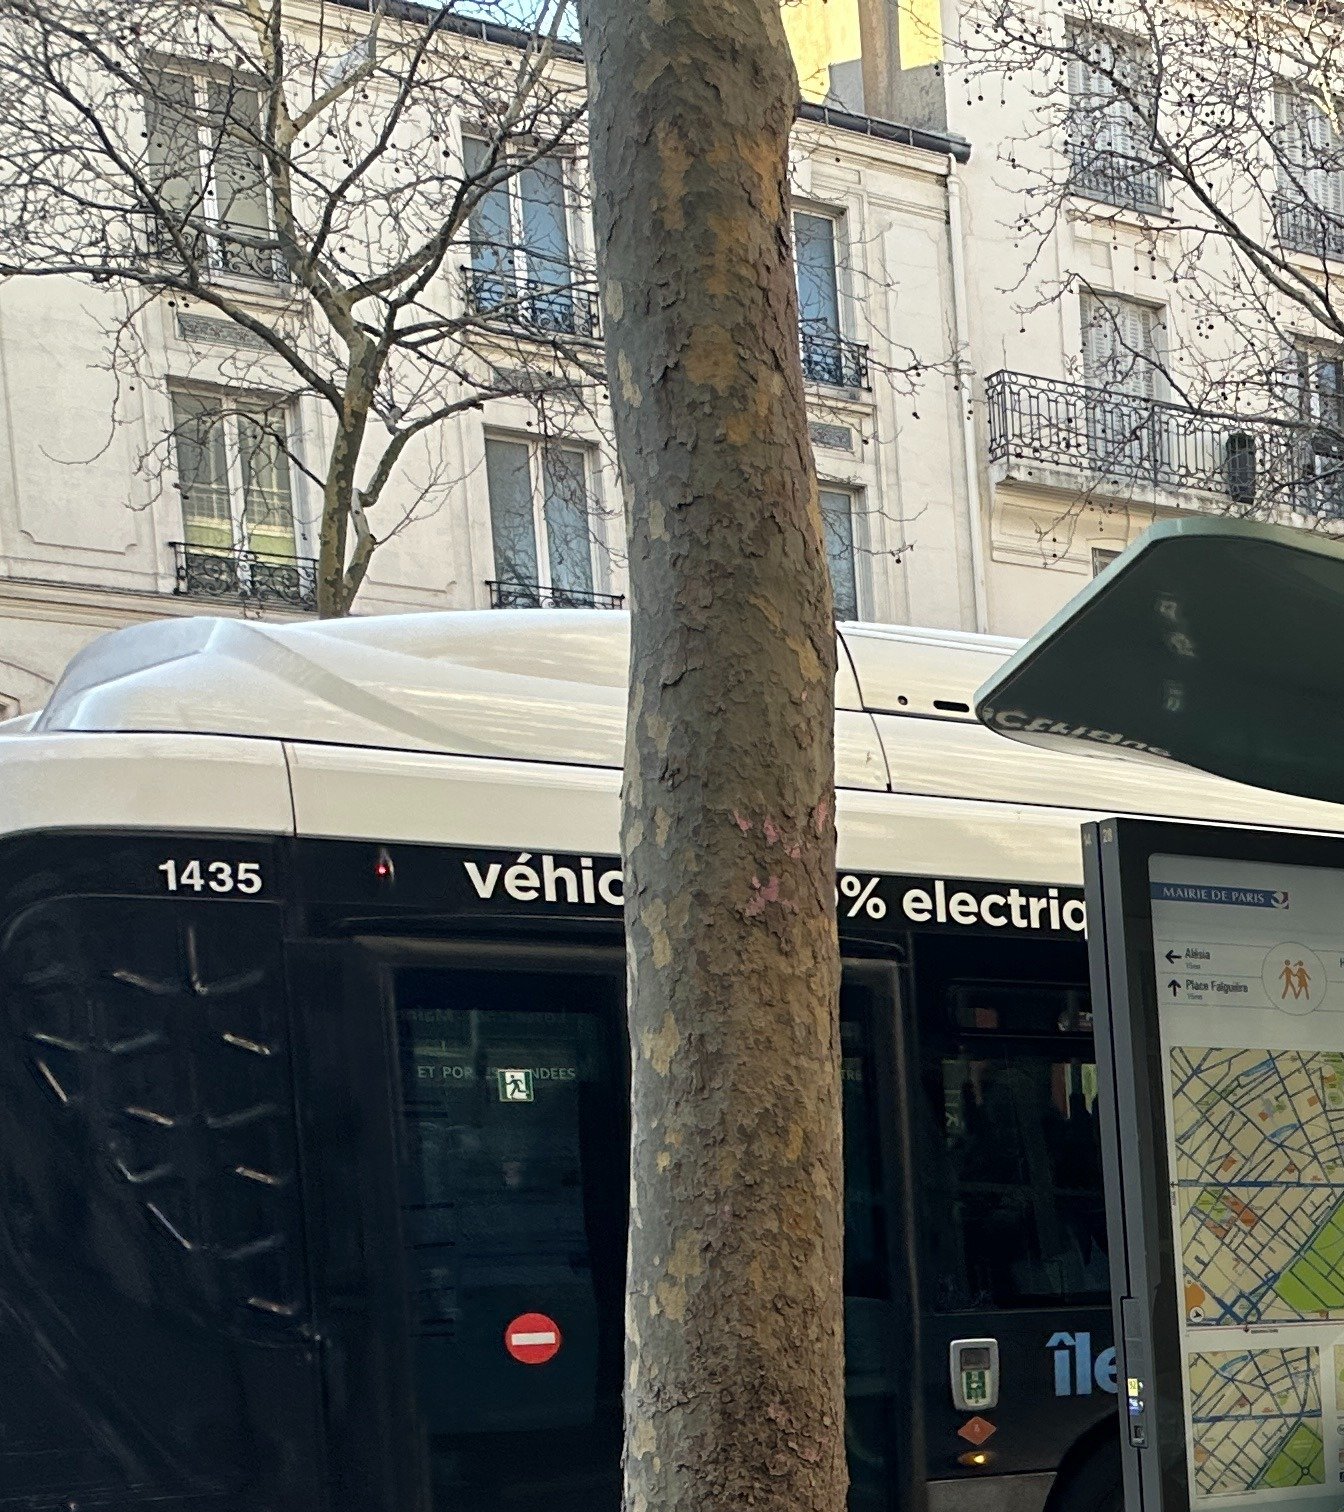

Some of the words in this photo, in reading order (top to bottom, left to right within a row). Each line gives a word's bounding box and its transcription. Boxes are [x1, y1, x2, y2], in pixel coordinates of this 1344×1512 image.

[159, 860, 262, 894] 1435
[1163, 886, 1208, 900] MAIRIE
[1211, 889, 1228, 901] DE
[1231, 891, 1265, 905] PARIS
